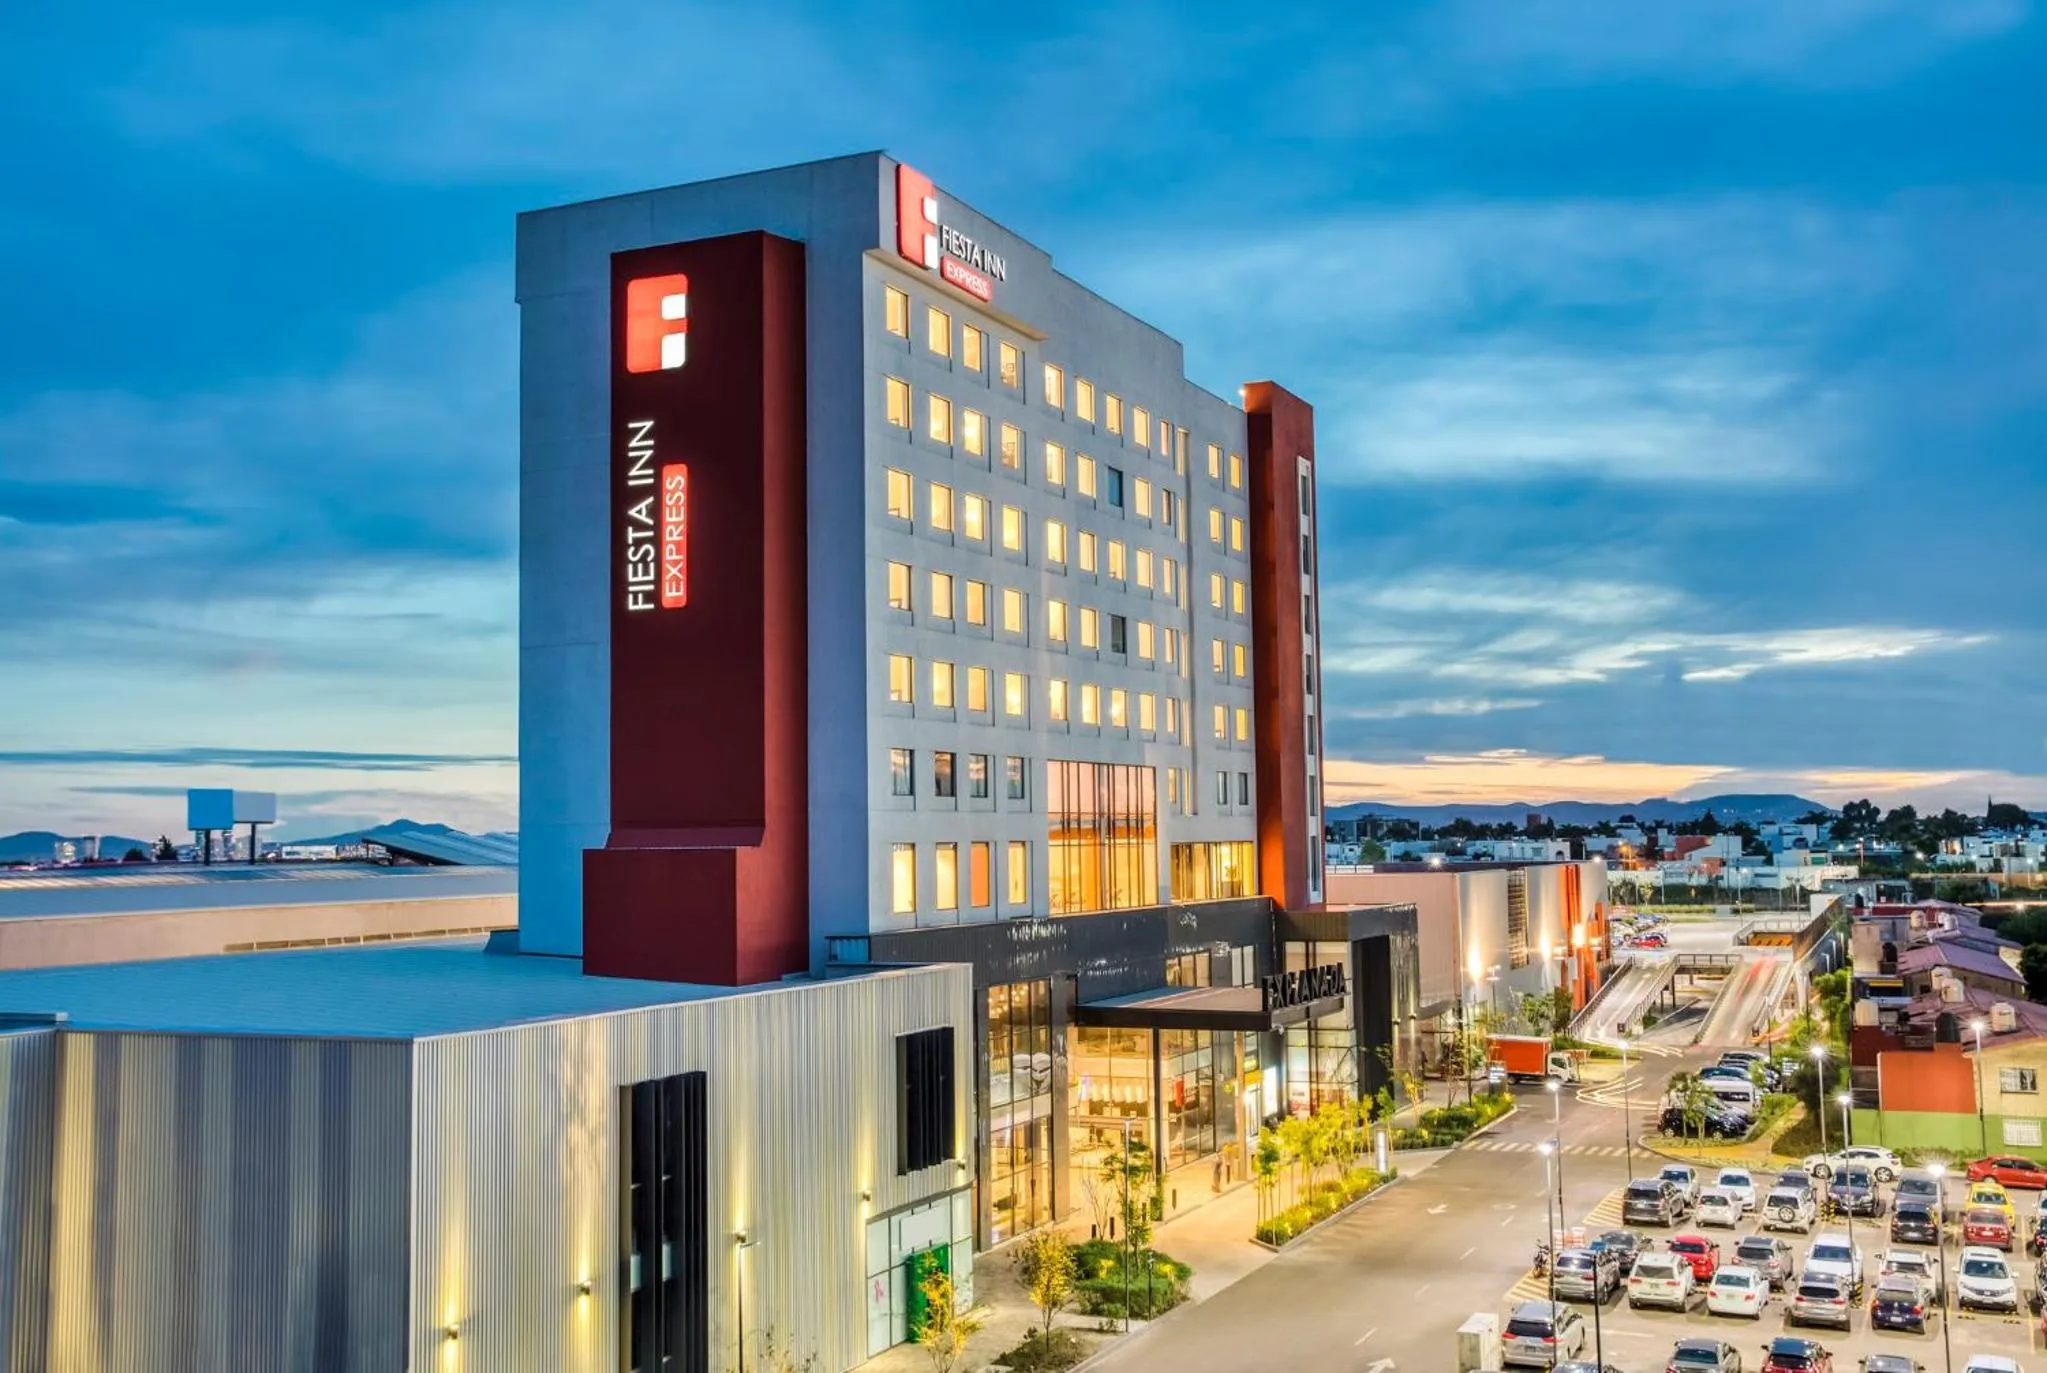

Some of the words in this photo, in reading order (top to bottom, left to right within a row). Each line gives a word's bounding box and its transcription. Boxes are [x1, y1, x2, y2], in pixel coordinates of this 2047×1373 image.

[940, 223, 981, 268] FIESTA
[981, 247, 1006, 282] INN
[945, 260, 989, 297] EXPRESS
[628, 420, 655, 486] INN
[628, 496, 655, 610] FIESTA
[665, 475, 685, 598] EXPRESS
